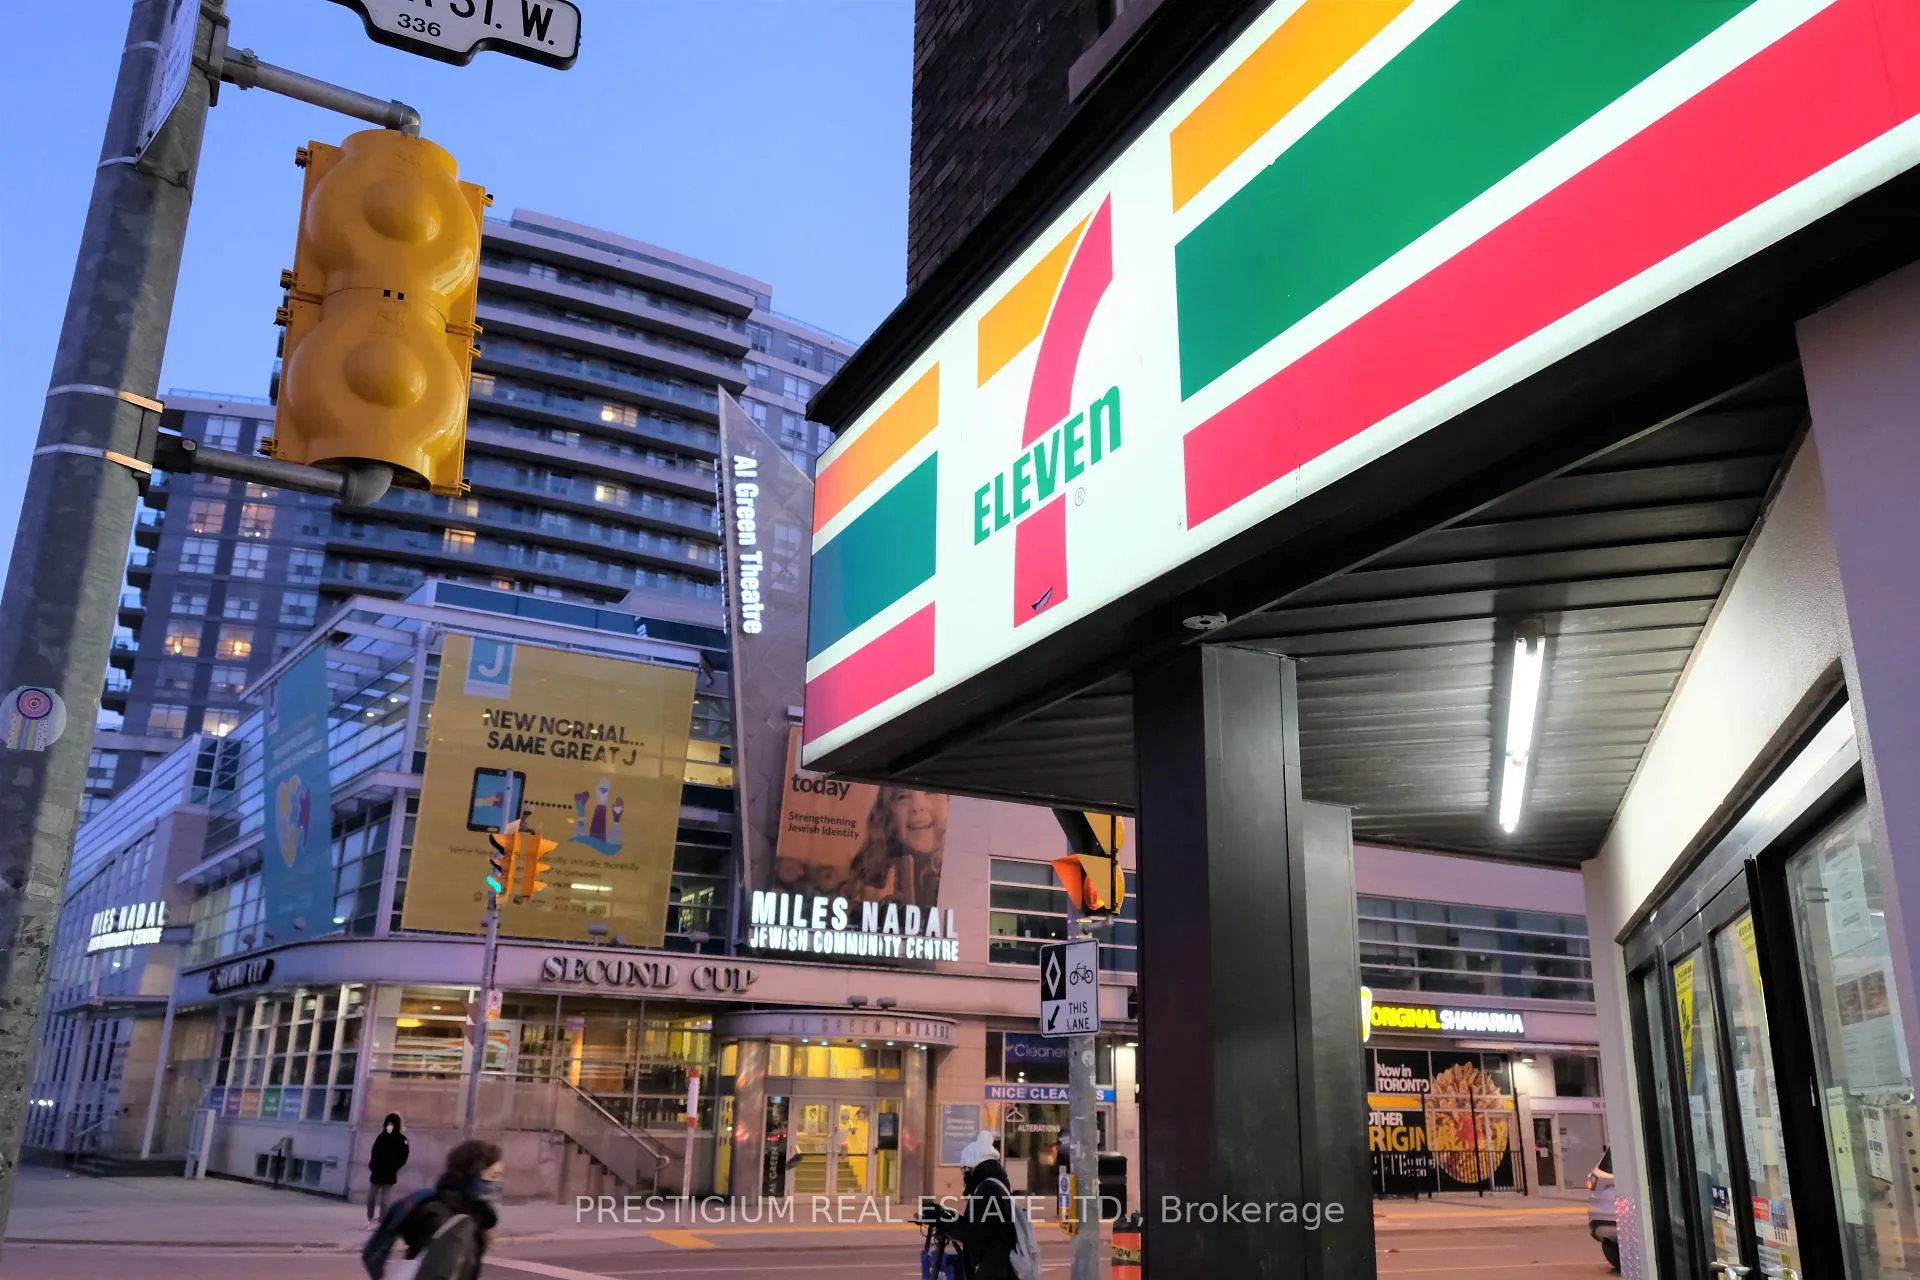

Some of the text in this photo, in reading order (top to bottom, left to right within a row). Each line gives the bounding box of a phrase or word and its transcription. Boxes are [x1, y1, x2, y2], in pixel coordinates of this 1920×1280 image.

[397, 13, 441, 37] 336
[521, 0, 555, 46] W.
[978, 191, 1113, 628] 7
[733, 455, 765, 634] Al Green Theatre
[484, 708, 536, 732] NEW
[487, 731, 638, 766] SAME GREAT J
[792, 774, 851, 801] today
[788, 811, 857, 829] Strengthening
[788, 823, 860, 840] Jewish Identity
[751, 890, 960, 939] MILES NADAL
[750, 926, 960, 962] JEWISH COMMUNITY CENTRE
[542, 955, 759, 994] SECOND CUP
[1068, 1002, 1088, 1015] THIS
[1370, 1006, 1525, 1033] ORIGINAL SHAWARMA
[1066, 1017, 1090, 1031] LANE
[1377, 1063, 1412, 1077] Now in
[991, 1087, 1025, 1099] NICE
[1377, 1078, 1430, 1092] TORONTO
[1017, 1123, 1061, 1133] ALTERATIONS
[768, 1146, 779, 1179] GREEN
